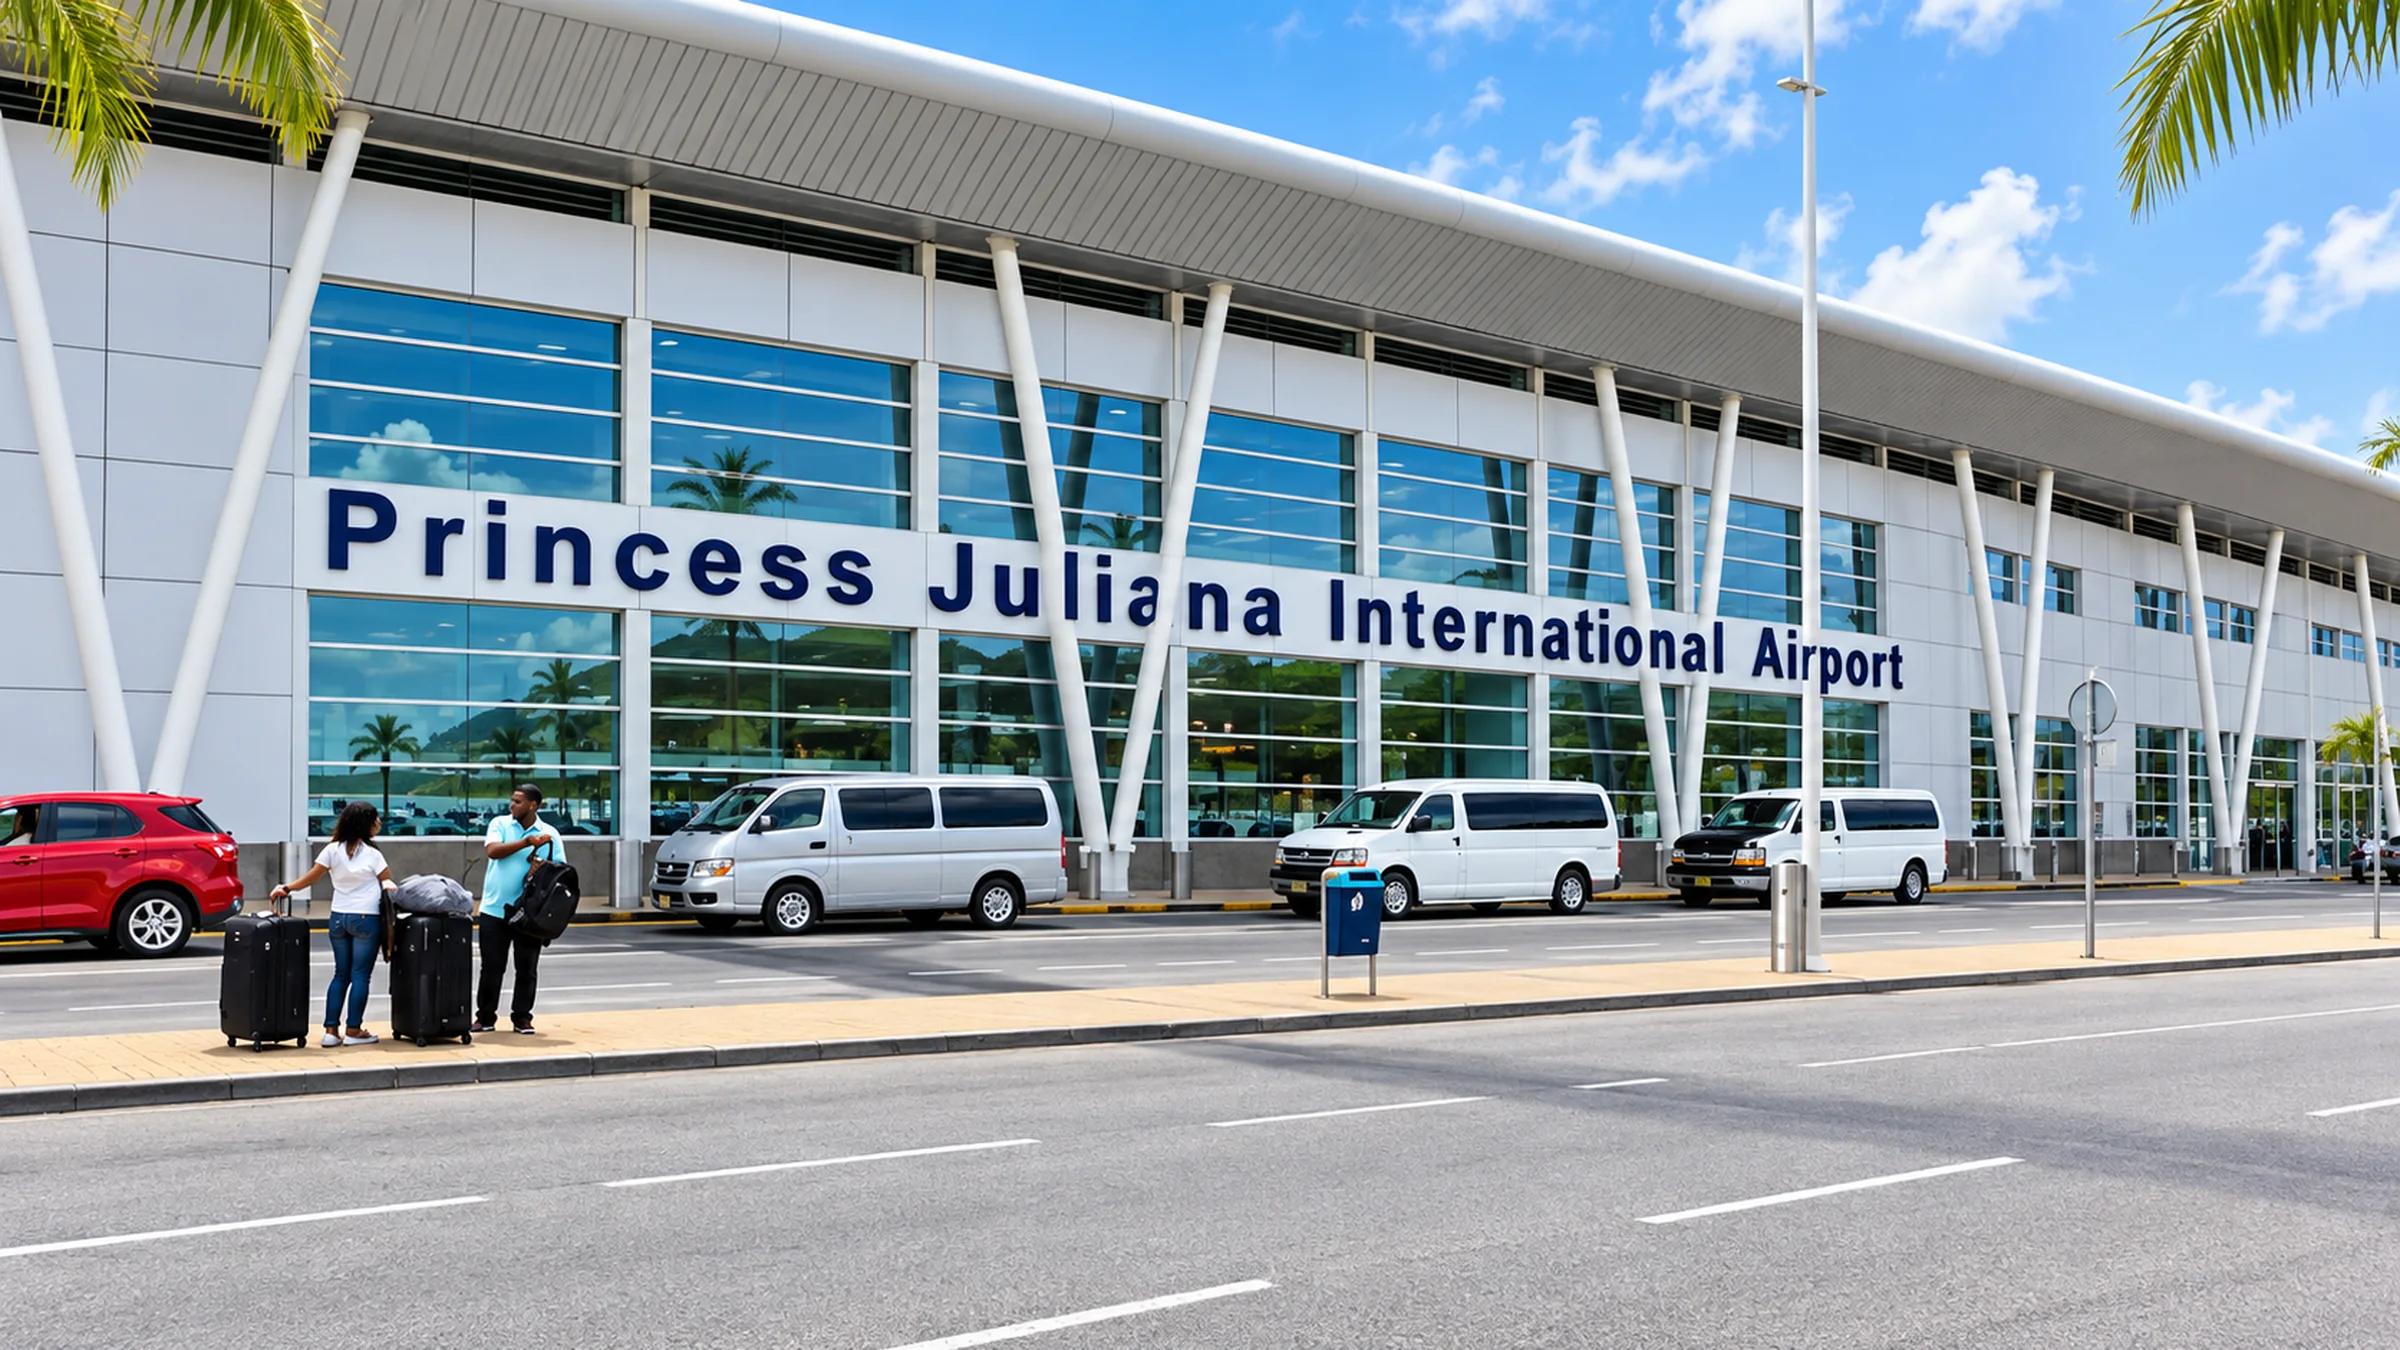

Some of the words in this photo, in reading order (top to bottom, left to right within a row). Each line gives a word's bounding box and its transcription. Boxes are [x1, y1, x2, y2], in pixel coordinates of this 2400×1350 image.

[328, 488, 874, 605] Princess
[928, 541, 1282, 637] Juliana
[1330, 578, 1724, 674] International
[1751, 627, 1903, 695] Airport
